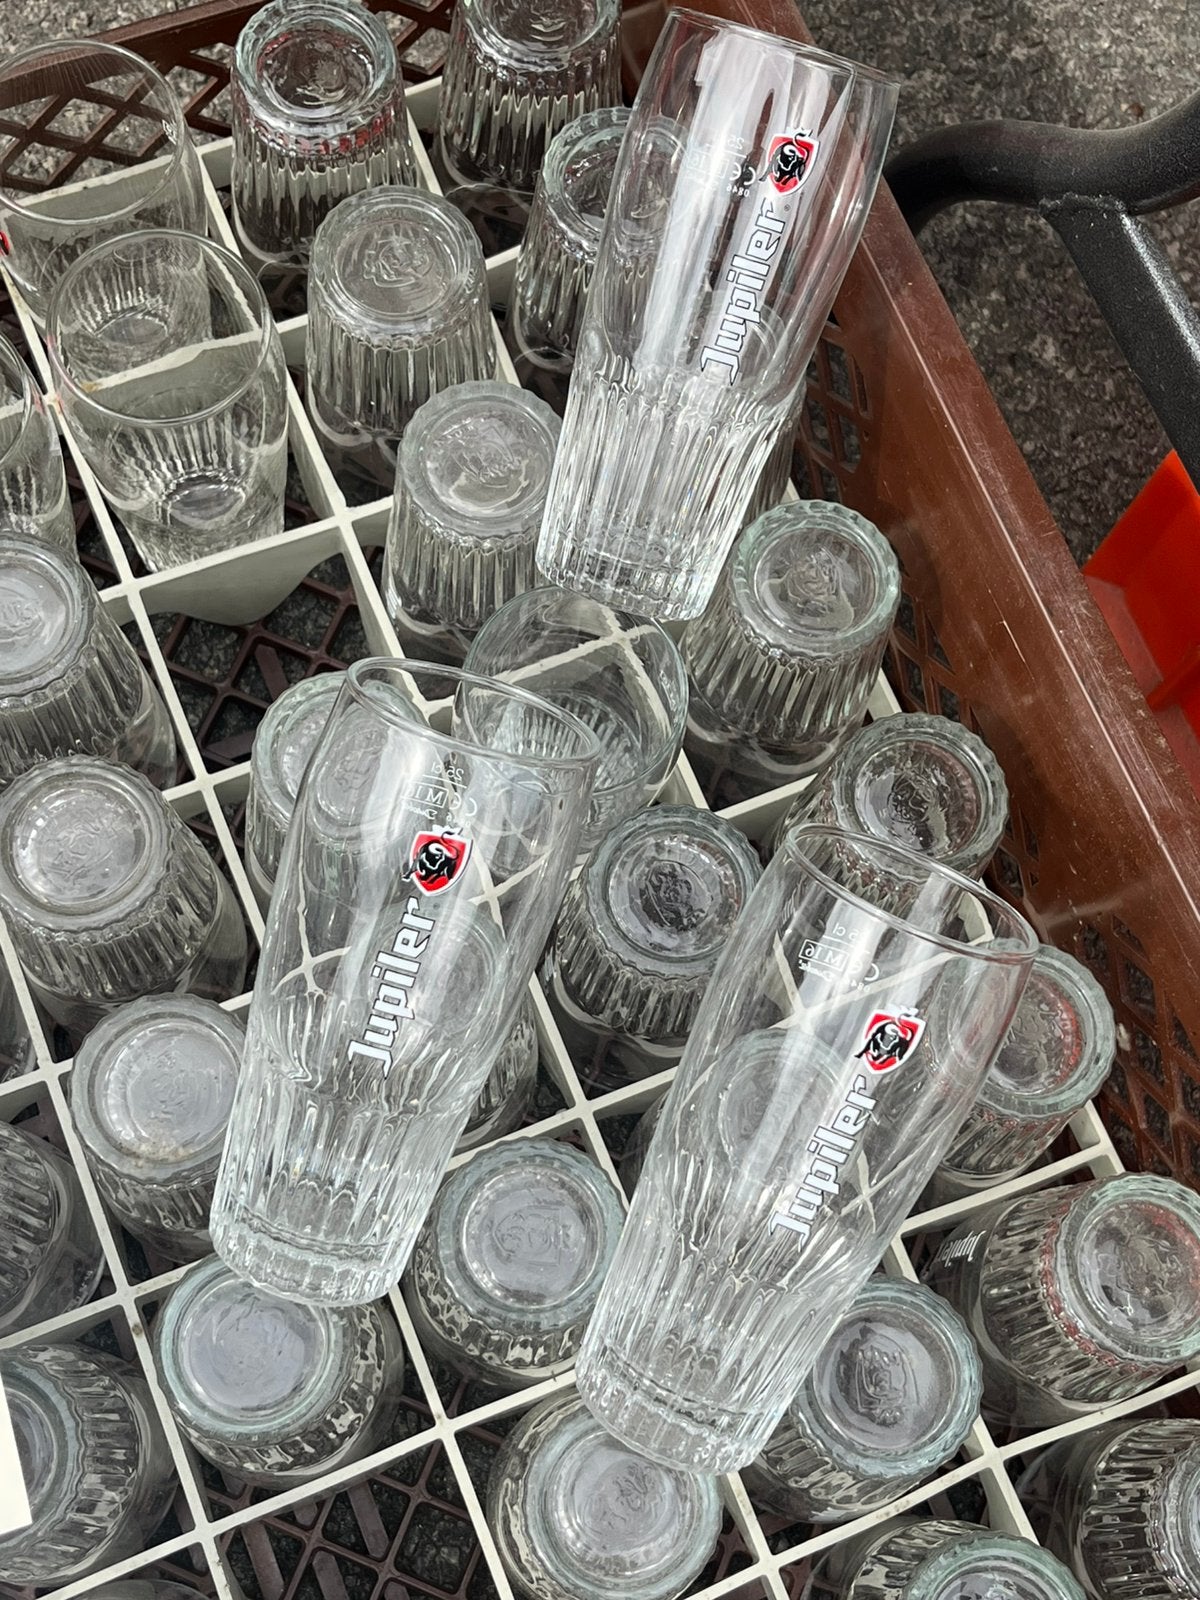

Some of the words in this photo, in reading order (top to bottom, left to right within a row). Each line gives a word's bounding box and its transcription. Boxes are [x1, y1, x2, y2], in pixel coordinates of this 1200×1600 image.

[700, 196, 786, 386] Jupiler
[348, 896, 436, 1079] Jupiler
[768, 1073, 878, 1253] Jupiler
